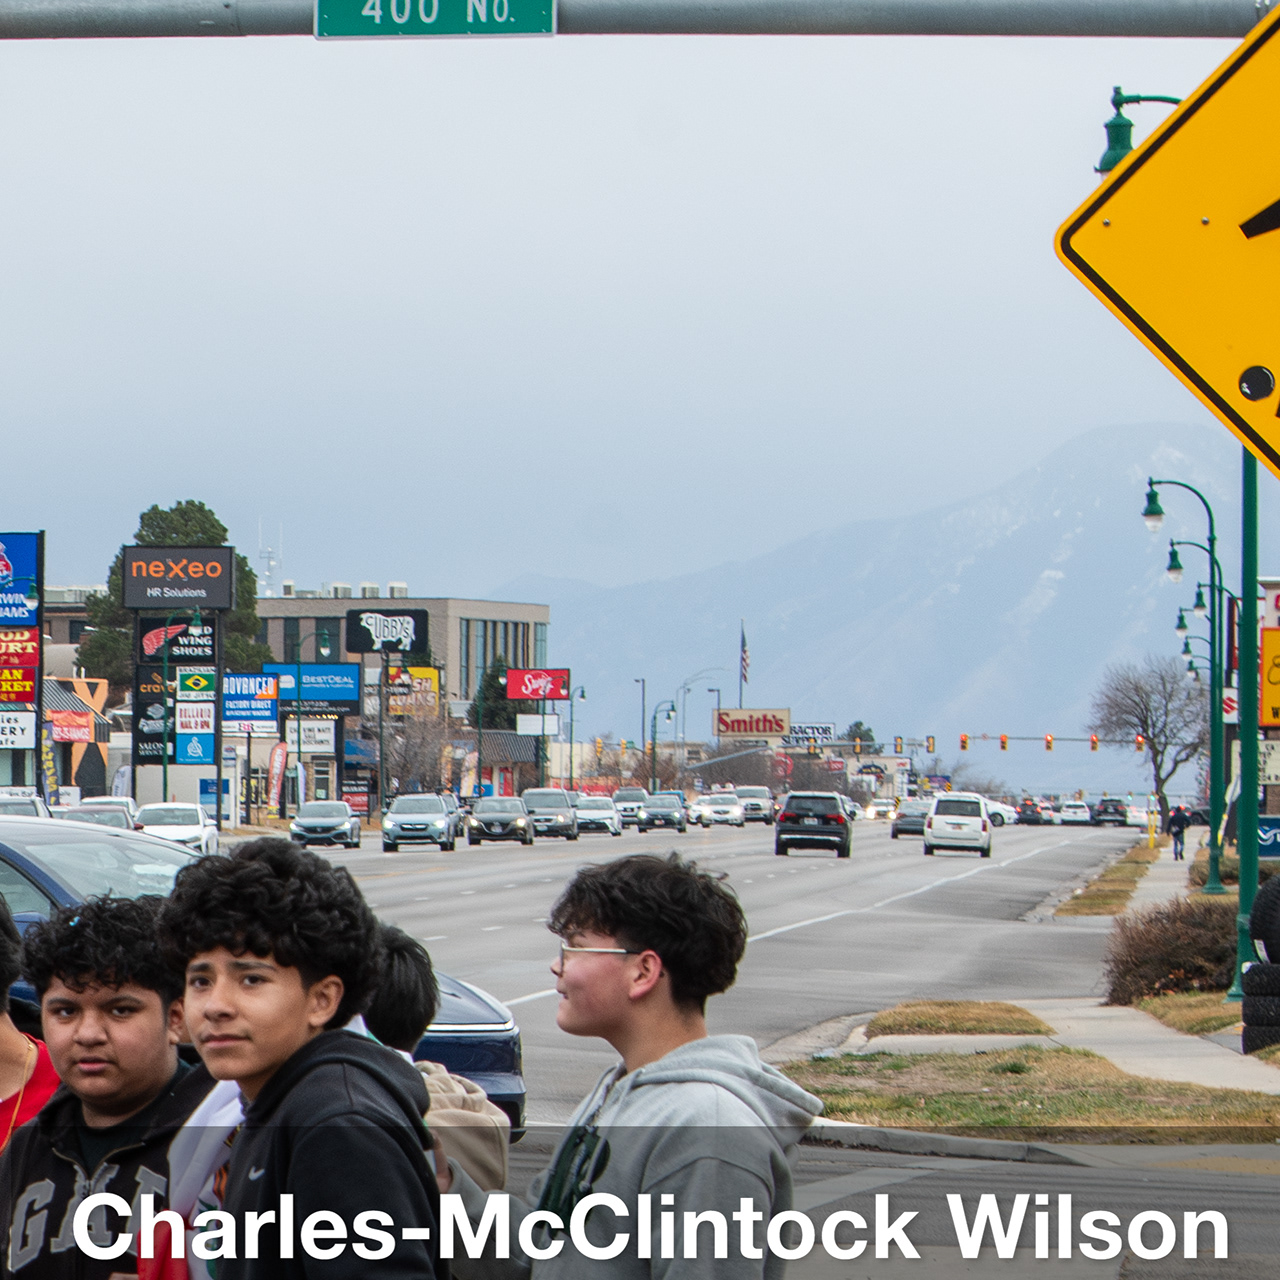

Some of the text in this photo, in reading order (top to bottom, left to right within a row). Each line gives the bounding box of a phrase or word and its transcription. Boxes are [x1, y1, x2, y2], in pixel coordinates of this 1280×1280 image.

[362, 0, 439, 24] 400
[132, 558, 222, 579] nexeo
[147, 587, 207, 597] HR Solutions
[178, 637, 212, 645] WING
[172, 647, 212, 656] SHOES
[223, 677, 274, 695] ADVANCED
[718, 713, 784, 733] Smith's
[789, 725, 832, 736] RACTOR
